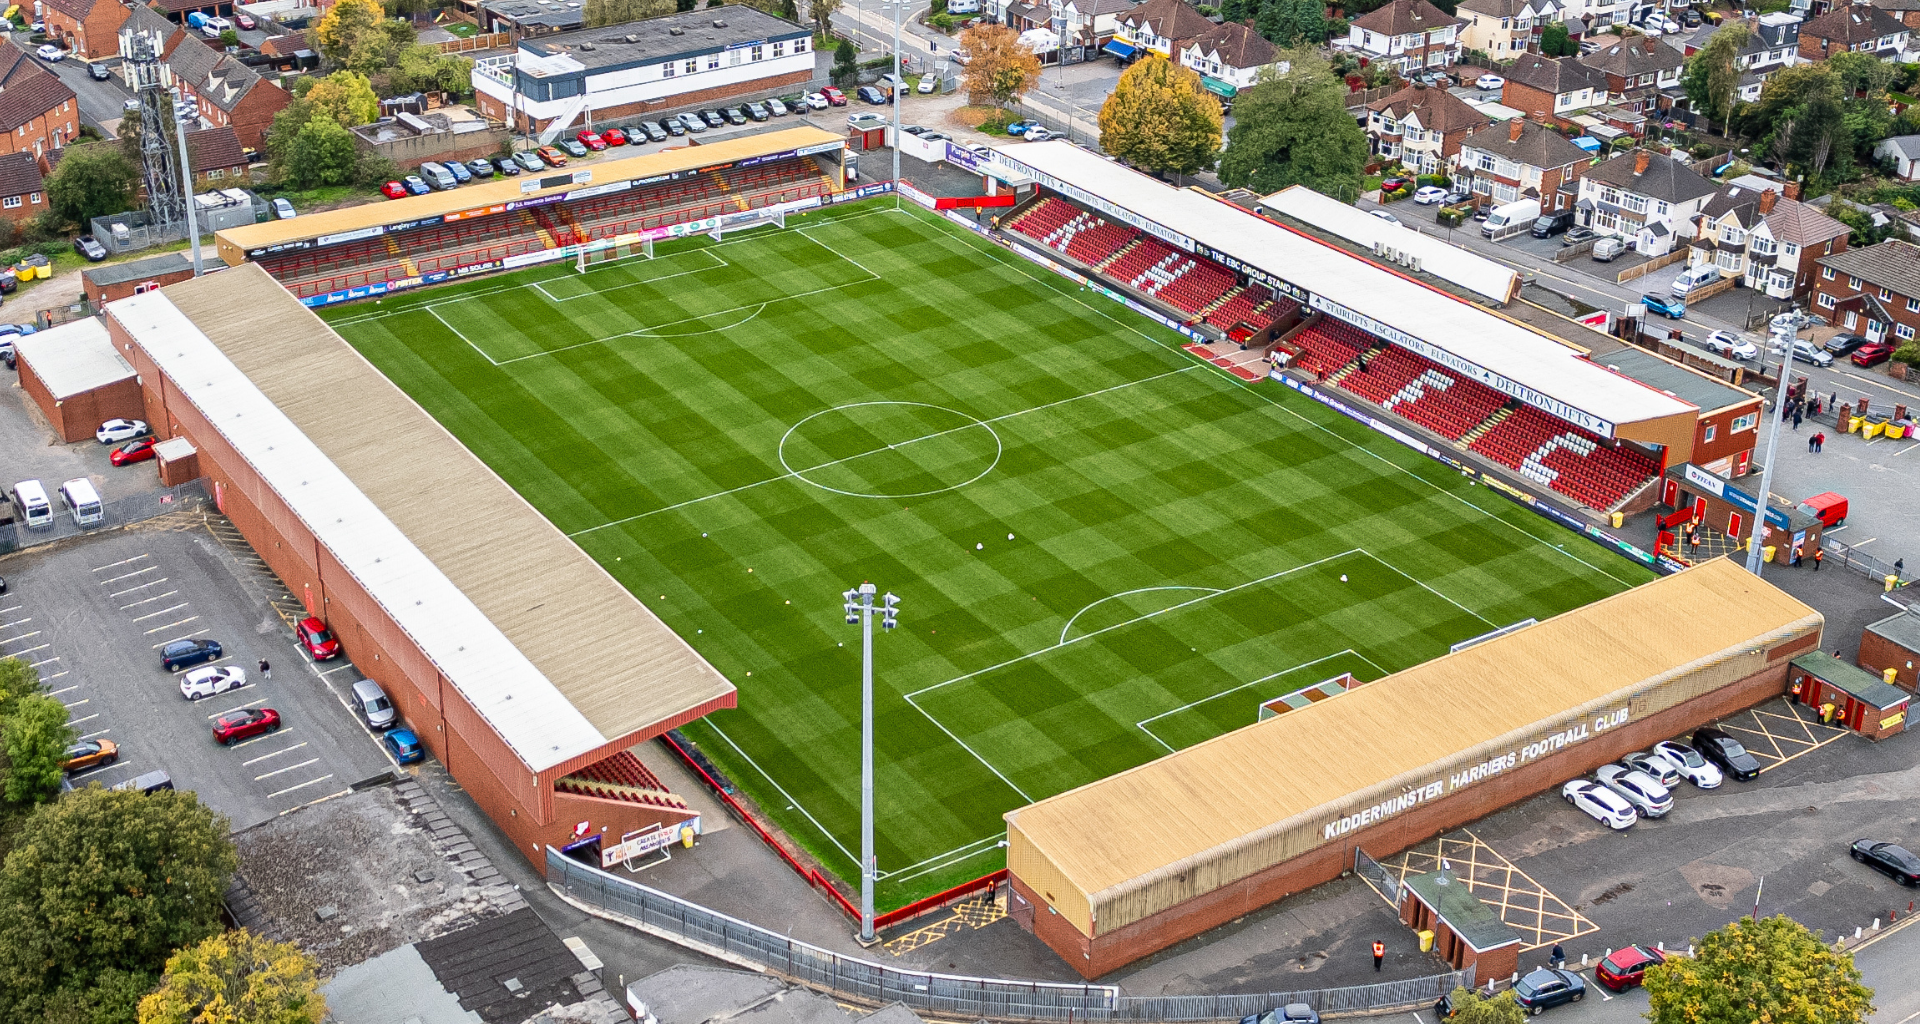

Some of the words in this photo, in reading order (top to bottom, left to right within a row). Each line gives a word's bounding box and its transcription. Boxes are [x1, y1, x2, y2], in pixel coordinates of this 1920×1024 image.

[999, 155, 1032, 179] DELTRON
[1034, 171, 1055, 187] LIFTS
[1066, 186, 1098, 206] STAIRLIFTS
[1102, 202, 1141, 225] ESCALATORS
[1145, 222, 1180, 243] ELEVATORS
[469, 262, 493, 271] SOLAR
[1211, 250, 1225, 263] THE
[1226, 257, 1241, 270] EBC
[1242, 264, 1266, 281] GROUP
[1267, 275, 1291, 293] STAND
[1325, 303, 1368, 327] STAIRLIFTS
[1374, 324, 1425, 351] ESCALATORS
[1431, 349, 1478, 375] ELEVATORS
[1495, 377, 1553, 411] DELTRON
[1555, 403, 1591, 427] LIFTS
[1697, 475, 1718, 489] TITAN
[1324, 779, 1443, 839] KIDDERMINSTER
[1450, 752, 1516, 790] HARRIERS
[1521, 723, 1589, 762] FOOTBALL
[1595, 707, 1629, 732] CLUB
